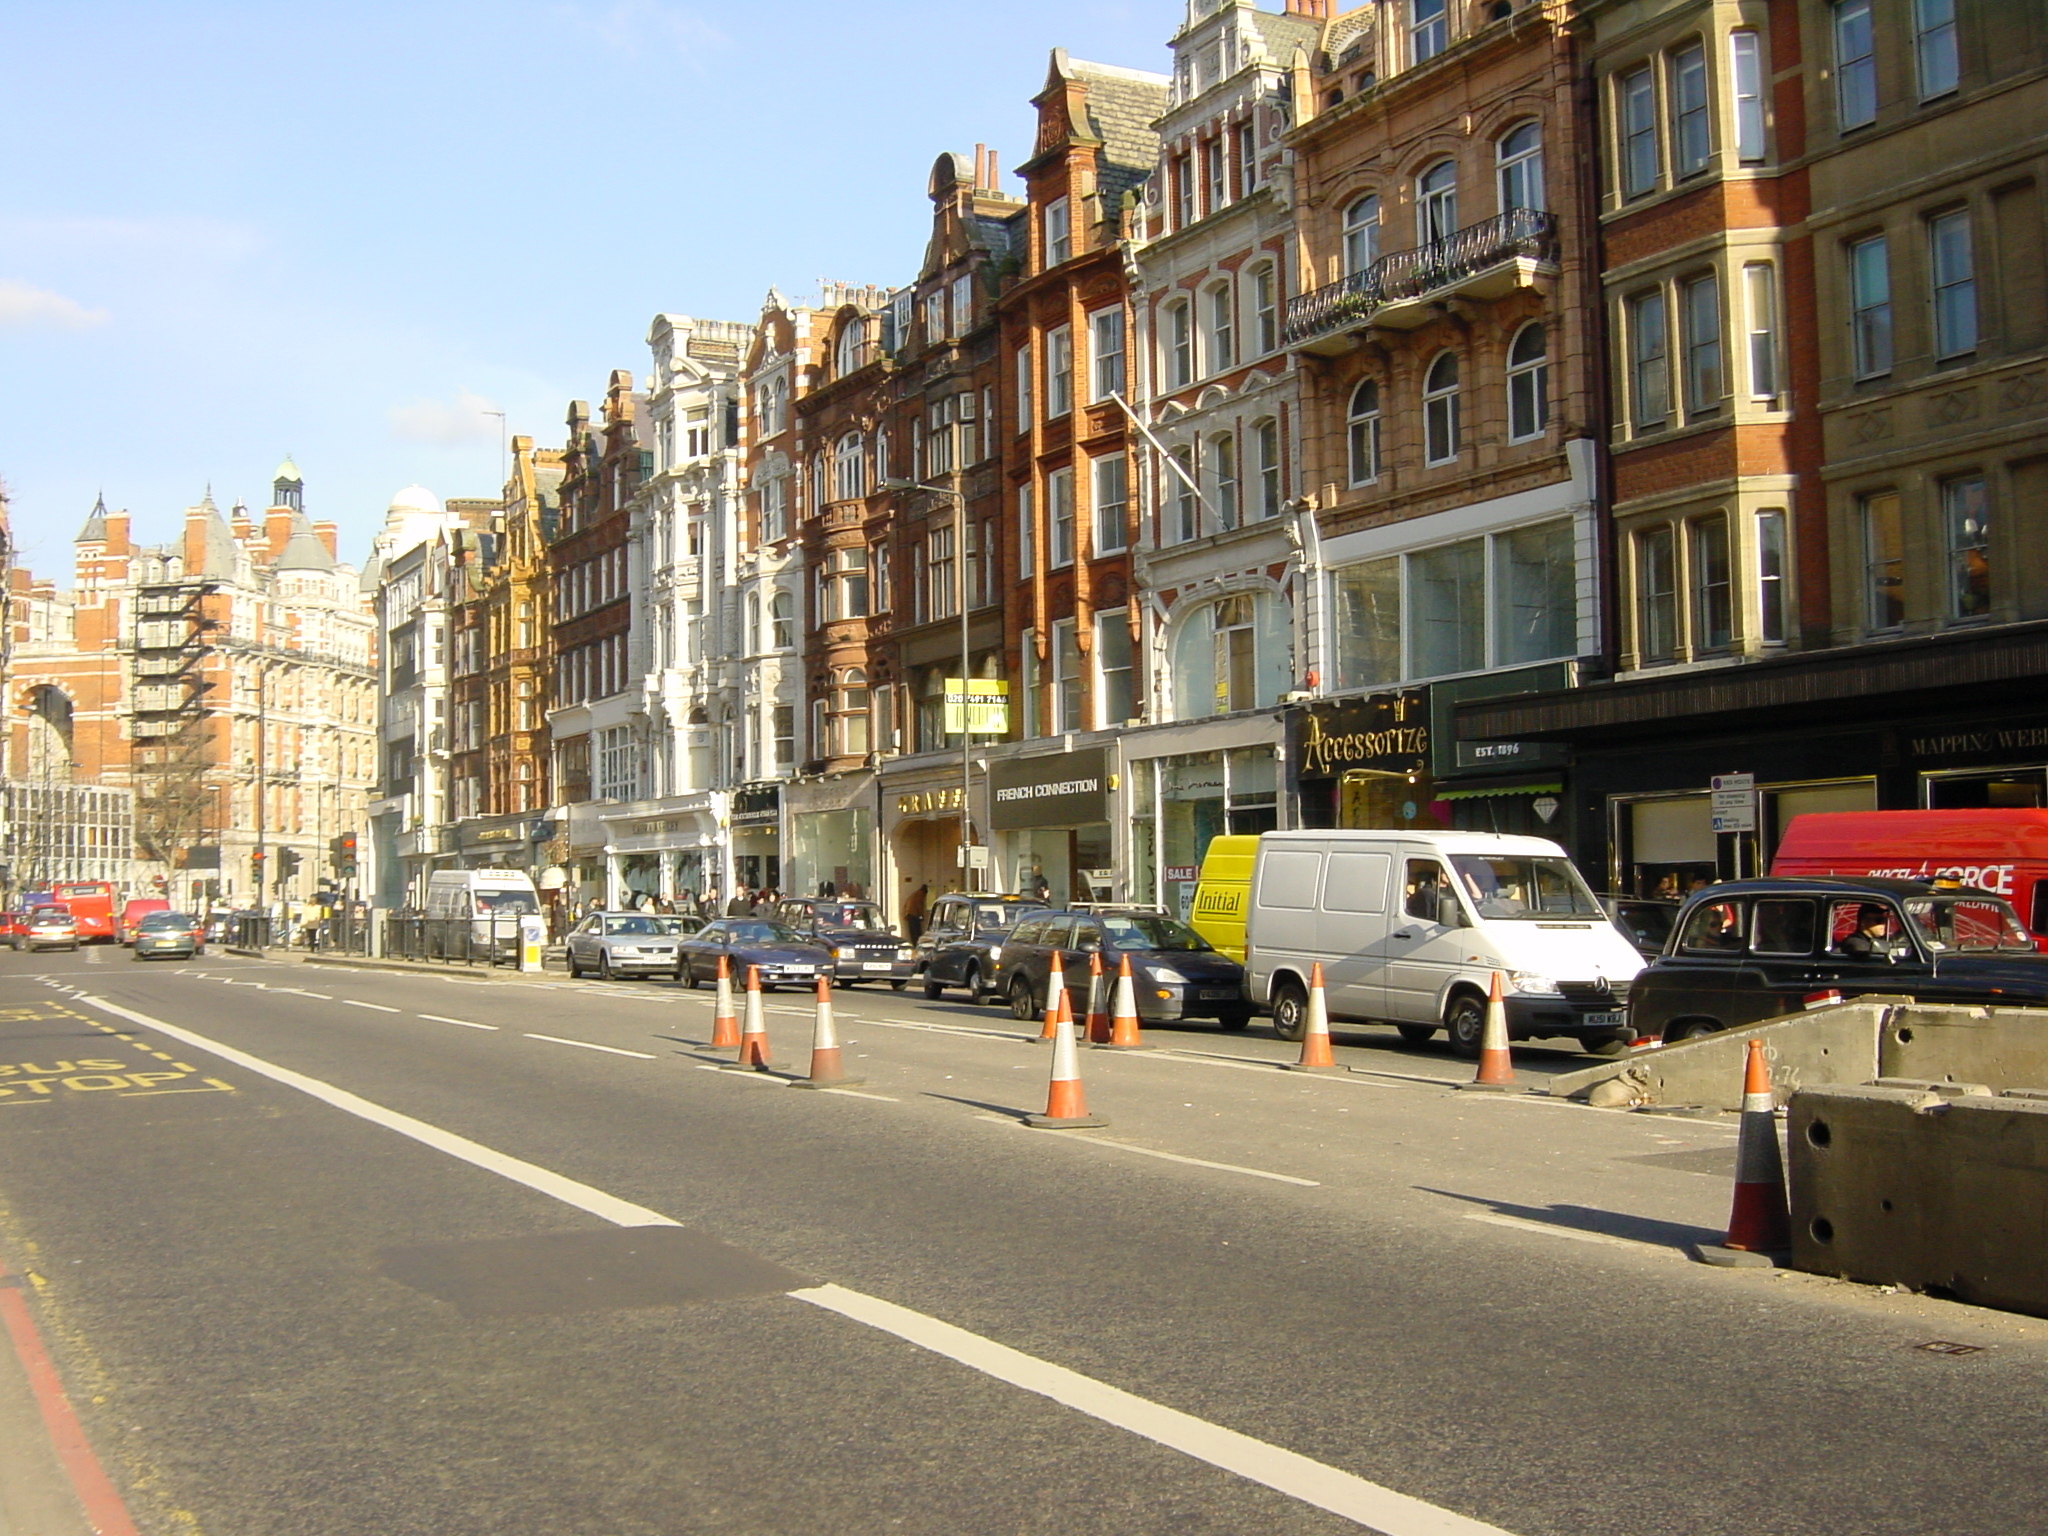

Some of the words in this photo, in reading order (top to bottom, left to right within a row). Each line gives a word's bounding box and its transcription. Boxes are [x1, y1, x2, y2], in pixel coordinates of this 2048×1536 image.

[1475, 746, 1495, 757] EST.
[1498, 743, 1519, 755] 1896
[1912, 733, 1982, 755] MAPPIN
[997, 786, 1033, 801] FRENCH
[1035, 779, 1098, 797] CONNECTION
[1168, 868, 1193, 879] SALE
[1198, 890, 1242, 911] Initial
